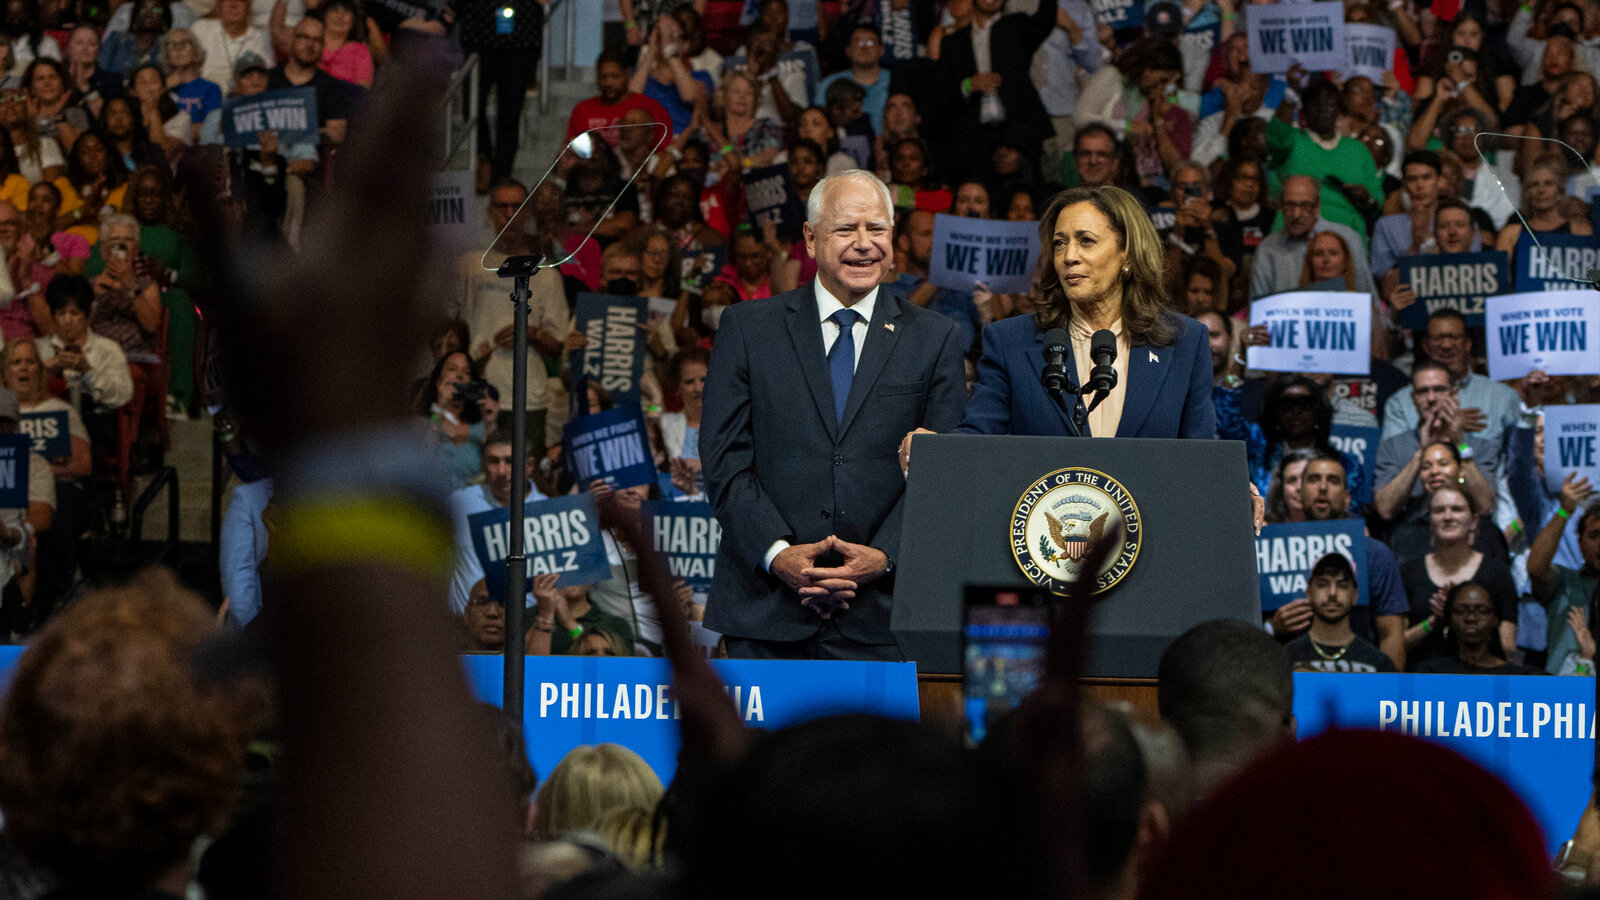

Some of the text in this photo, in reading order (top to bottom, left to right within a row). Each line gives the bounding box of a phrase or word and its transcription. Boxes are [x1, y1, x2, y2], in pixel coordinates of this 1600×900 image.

[1259, 27, 1333, 53] WE WIN
[1352, 46, 1387, 67] WIN
[233, 107, 307, 133] WE WIN
[946, 243, 1029, 276] WE WIN
[1410, 262, 1499, 298] HARRIS
[1265, 308, 1354, 318] WHEN WE VOTE
[1501, 307, 1584, 322] WHEN WE VOTE
[582, 318, 604, 377] WALZ
[600, 305, 638, 393] HARRIS
[1264, 320, 1356, 350] WE WIN
[1500, 320, 1587, 355] WE WIN
[1561, 423, 1596, 433] WHEN
[572, 431, 645, 481] WE WIN
[1558, 436, 1596, 468] WE
[1055, 473, 1071, 484] OF
[1074, 472, 1100, 486] THE
[1013, 479, 1051, 555] PRESIDENT
[1103, 480, 1139, 533] UNITED
[483, 509, 591, 562] HRRIS
[1022, 559, 1053, 591] VICE
[1096, 541, 1138, 589] STATES
[539, 682, 765, 722] PHILADEIA
[1379, 700, 1596, 740] PHILADELPHI
